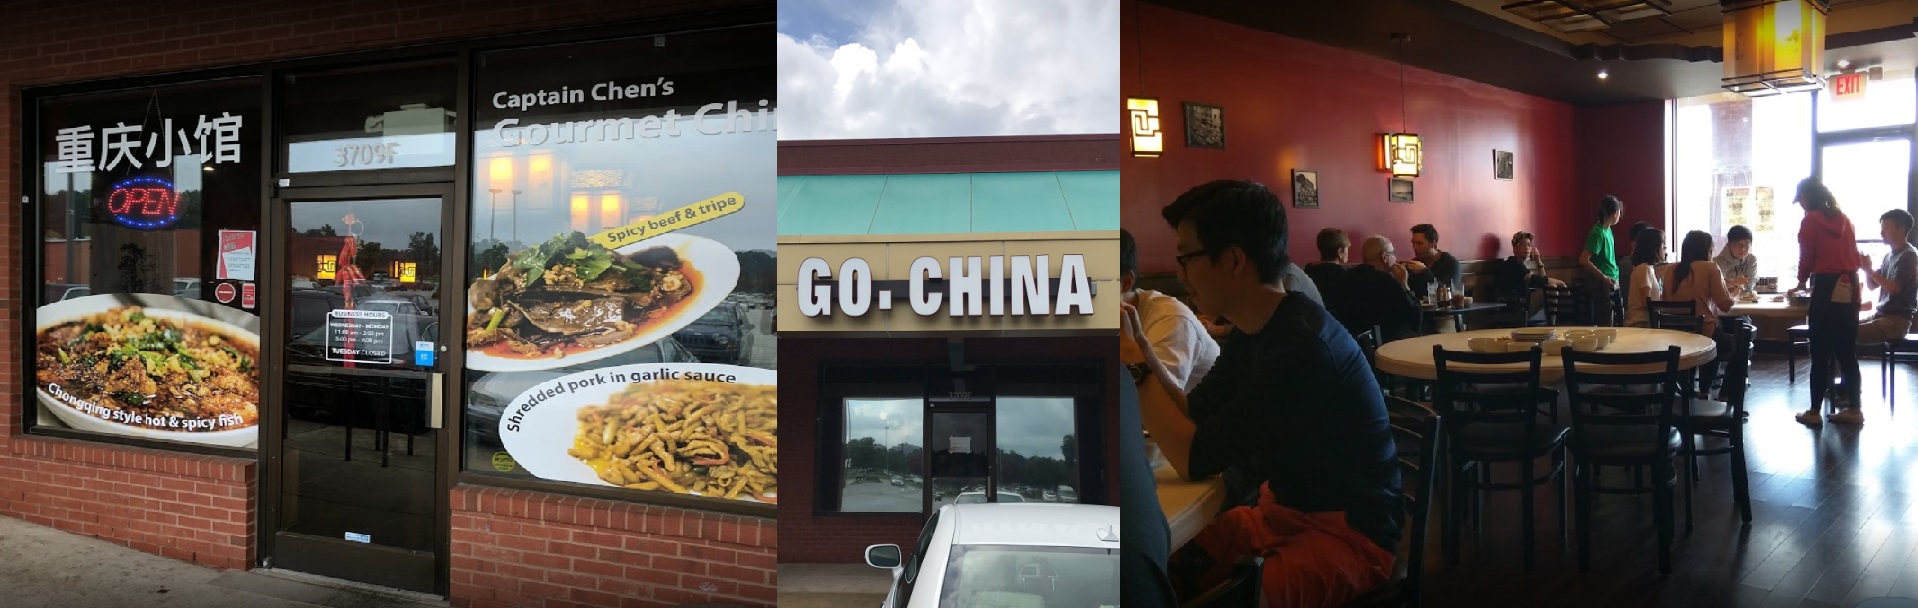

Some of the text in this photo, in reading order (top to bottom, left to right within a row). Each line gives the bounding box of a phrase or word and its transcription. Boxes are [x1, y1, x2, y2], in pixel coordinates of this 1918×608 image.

[492, 77, 675, 112] Captain Chen's
[1835, 74, 1861, 95] EXIT
[55, 112, 243, 173] 重庆小馆
[493, 108, 682, 148] Gourmet
[334, 142, 400, 167] 3709F
[107, 188, 181, 215] OPEN
[607, 197, 737, 242] Spicy beef & tripe
[909, 254, 1094, 316] CHINA
[48, 382, 244, 431] Chongqing style hot & spicy fish
[507, 368, 737, 432] Shredded pork in garlic sauce
